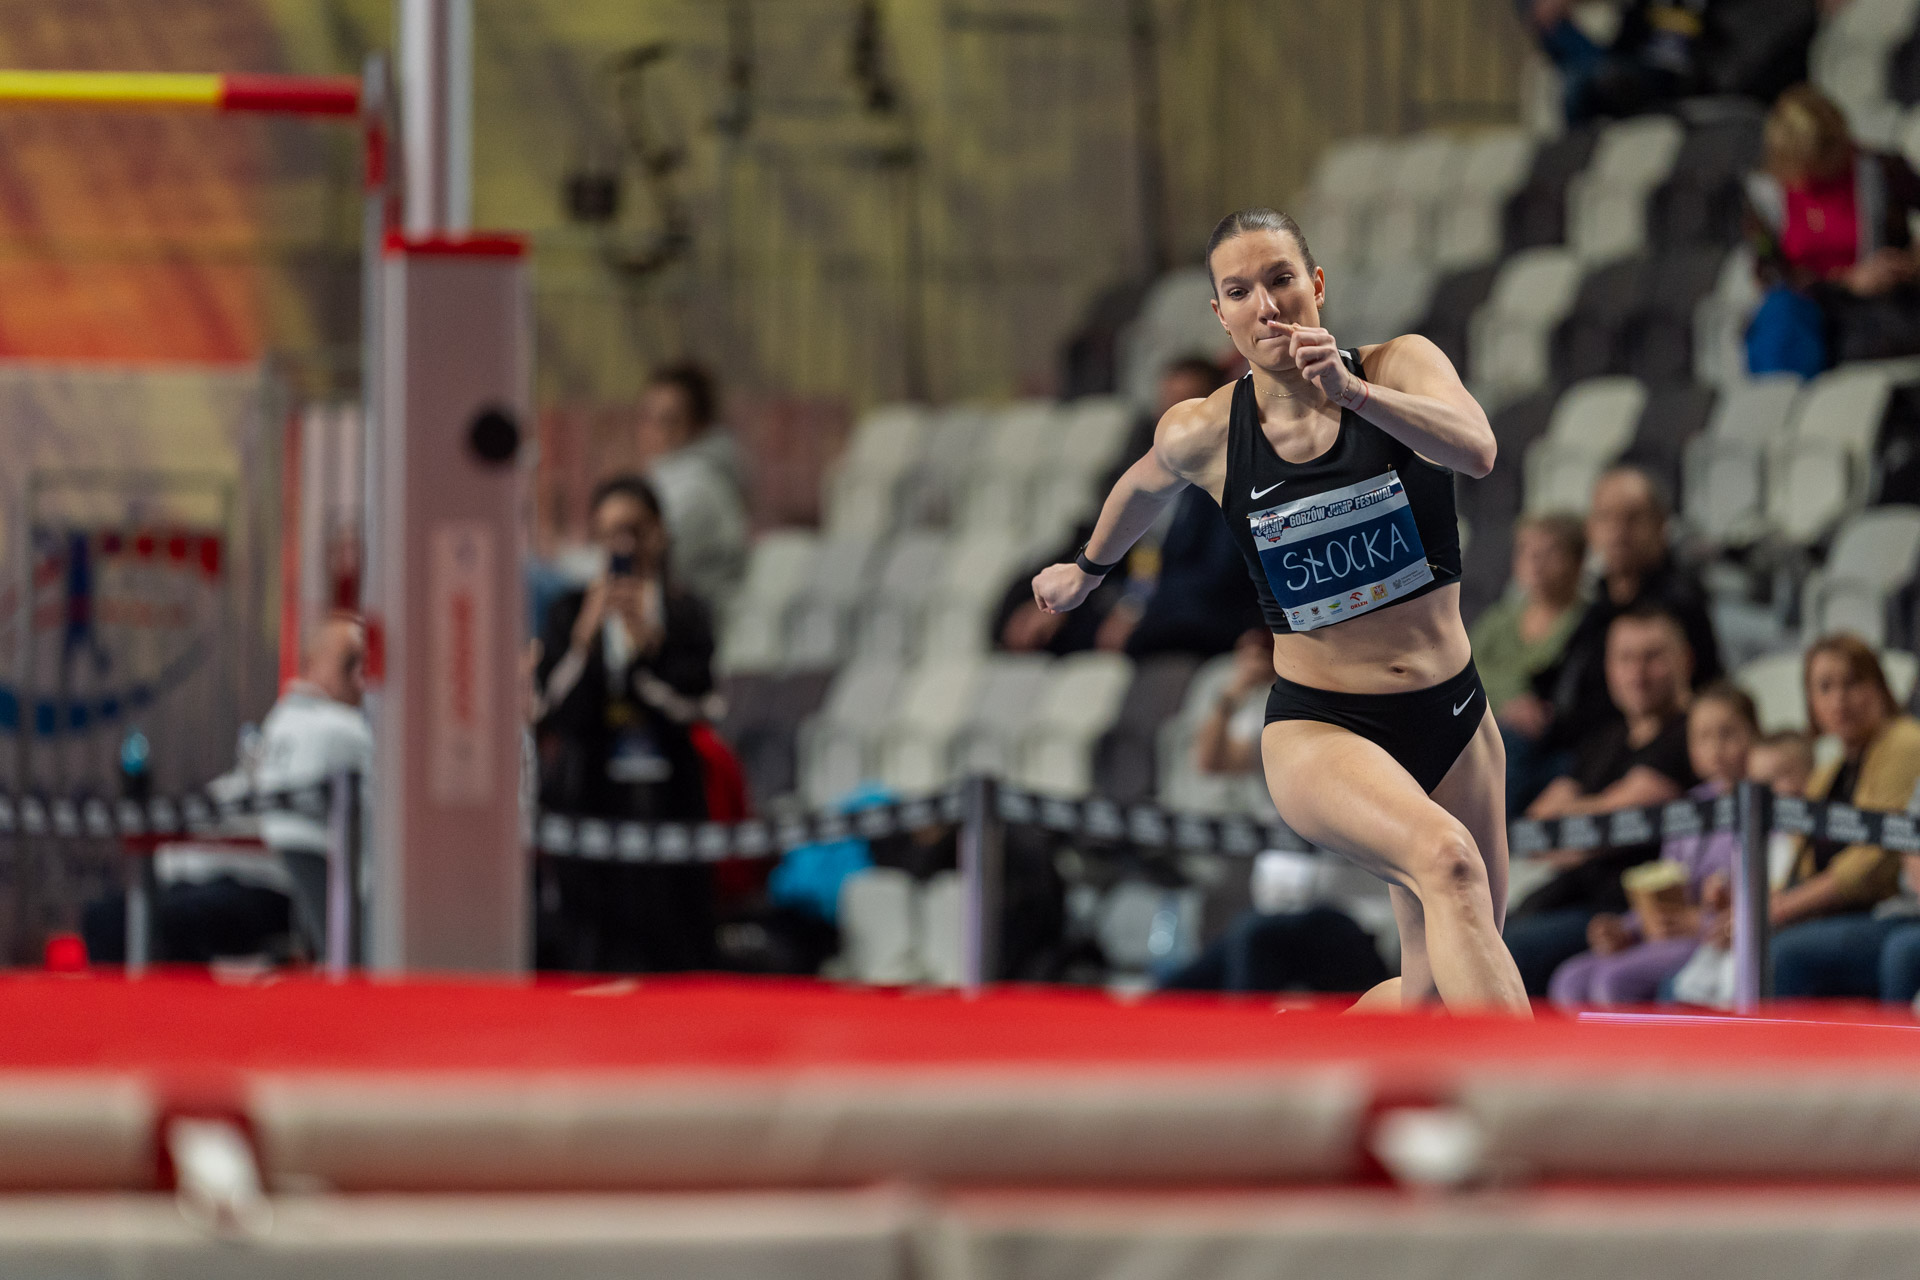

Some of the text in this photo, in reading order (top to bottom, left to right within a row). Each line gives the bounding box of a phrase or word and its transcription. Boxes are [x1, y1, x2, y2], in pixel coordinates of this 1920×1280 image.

[1289, 486, 1394, 528] GORZÓW JUMP FESTIVAL
[1283, 522, 1410, 591] SŁOCKA
[1350, 600, 1369, 610] ORLEN
